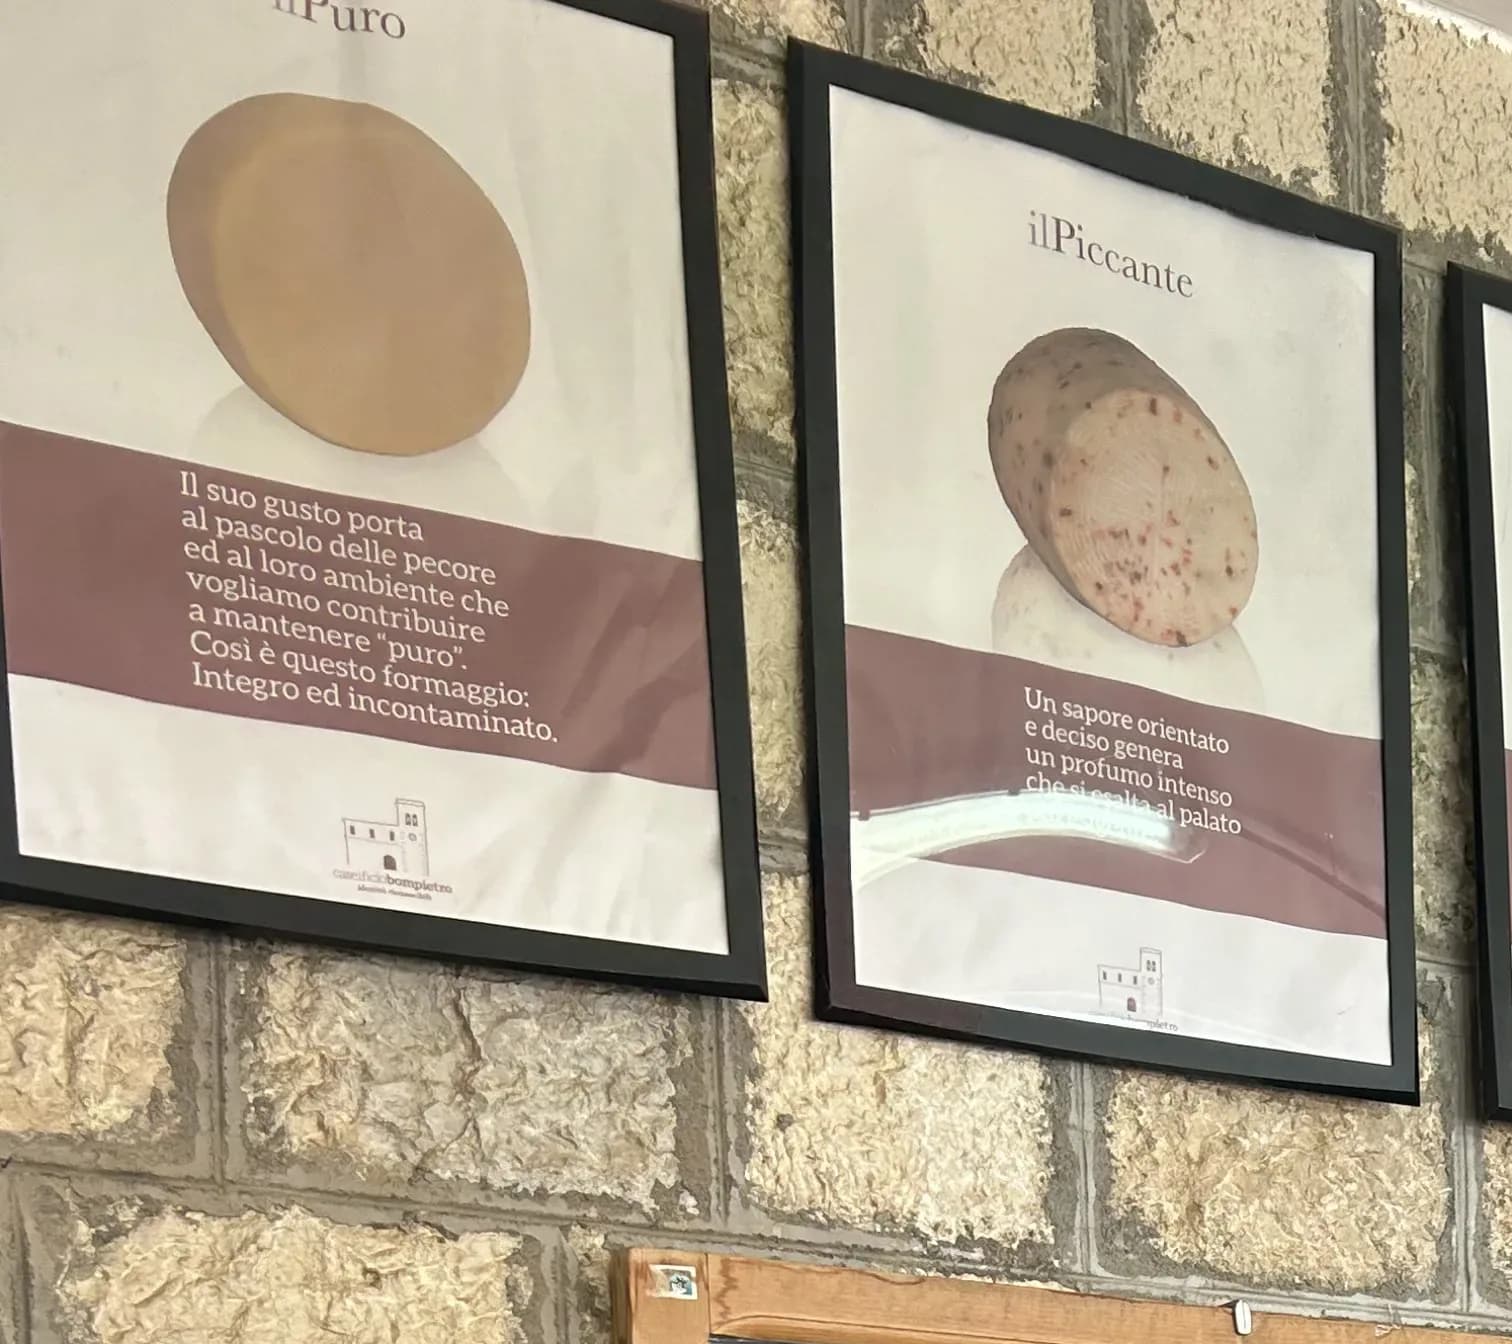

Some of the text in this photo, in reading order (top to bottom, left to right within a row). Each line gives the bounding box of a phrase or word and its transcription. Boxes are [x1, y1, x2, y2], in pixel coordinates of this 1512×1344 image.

[273, 0, 406, 39] Puro
[1028, 210, 1193, 298] ilPiccante
[180, 471, 424, 541] Il suo gusto porta
[181, 507, 496, 585] al pascolo delle pecore
[184, 540, 509, 617] ed al loro ambiente che
[186, 571, 486, 643] vogliamo contribuire
[189, 603, 205, 622] a
[214, 605, 371, 652] mantenere
[190, 630, 529, 707] Così è questo formaggio:
[192, 662, 558, 742] Integro ed incontaminato.
[1024, 686, 1230, 754] Un sapore orientato
[1025, 720, 1184, 770] e deciso genera
[1026, 748, 1232, 807] un profumo intenso
[1157, 800, 1174, 820] al
[1180, 804, 1242, 834] palato
